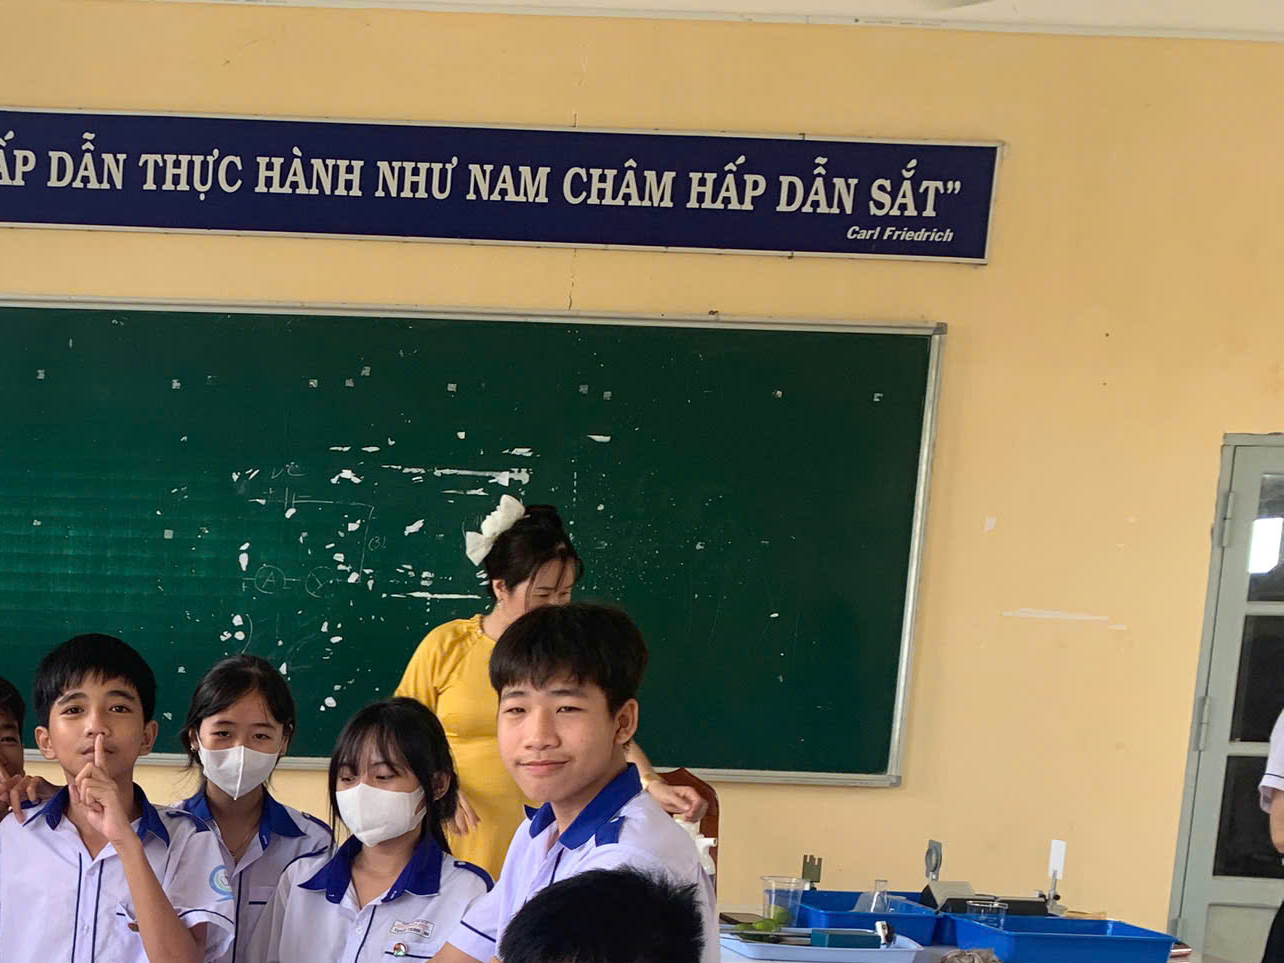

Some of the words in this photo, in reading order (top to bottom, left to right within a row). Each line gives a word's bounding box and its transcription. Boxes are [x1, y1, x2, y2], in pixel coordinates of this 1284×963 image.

[46, 132, 127, 190] DẪN
[138, 148, 244, 202] THỰC
[254, 146, 365, 197] HÀNH
[374, 157, 458, 200] NHƯ
[466, 163, 551, 205] NAM
[562, 158, 677, 209] CHÂM
[686, 155, 767, 212] HẤP
[775, 156, 859, 216] DẪN
[846, 225, 881, 240] Carl
[882, 227, 955, 242] Friedrich
